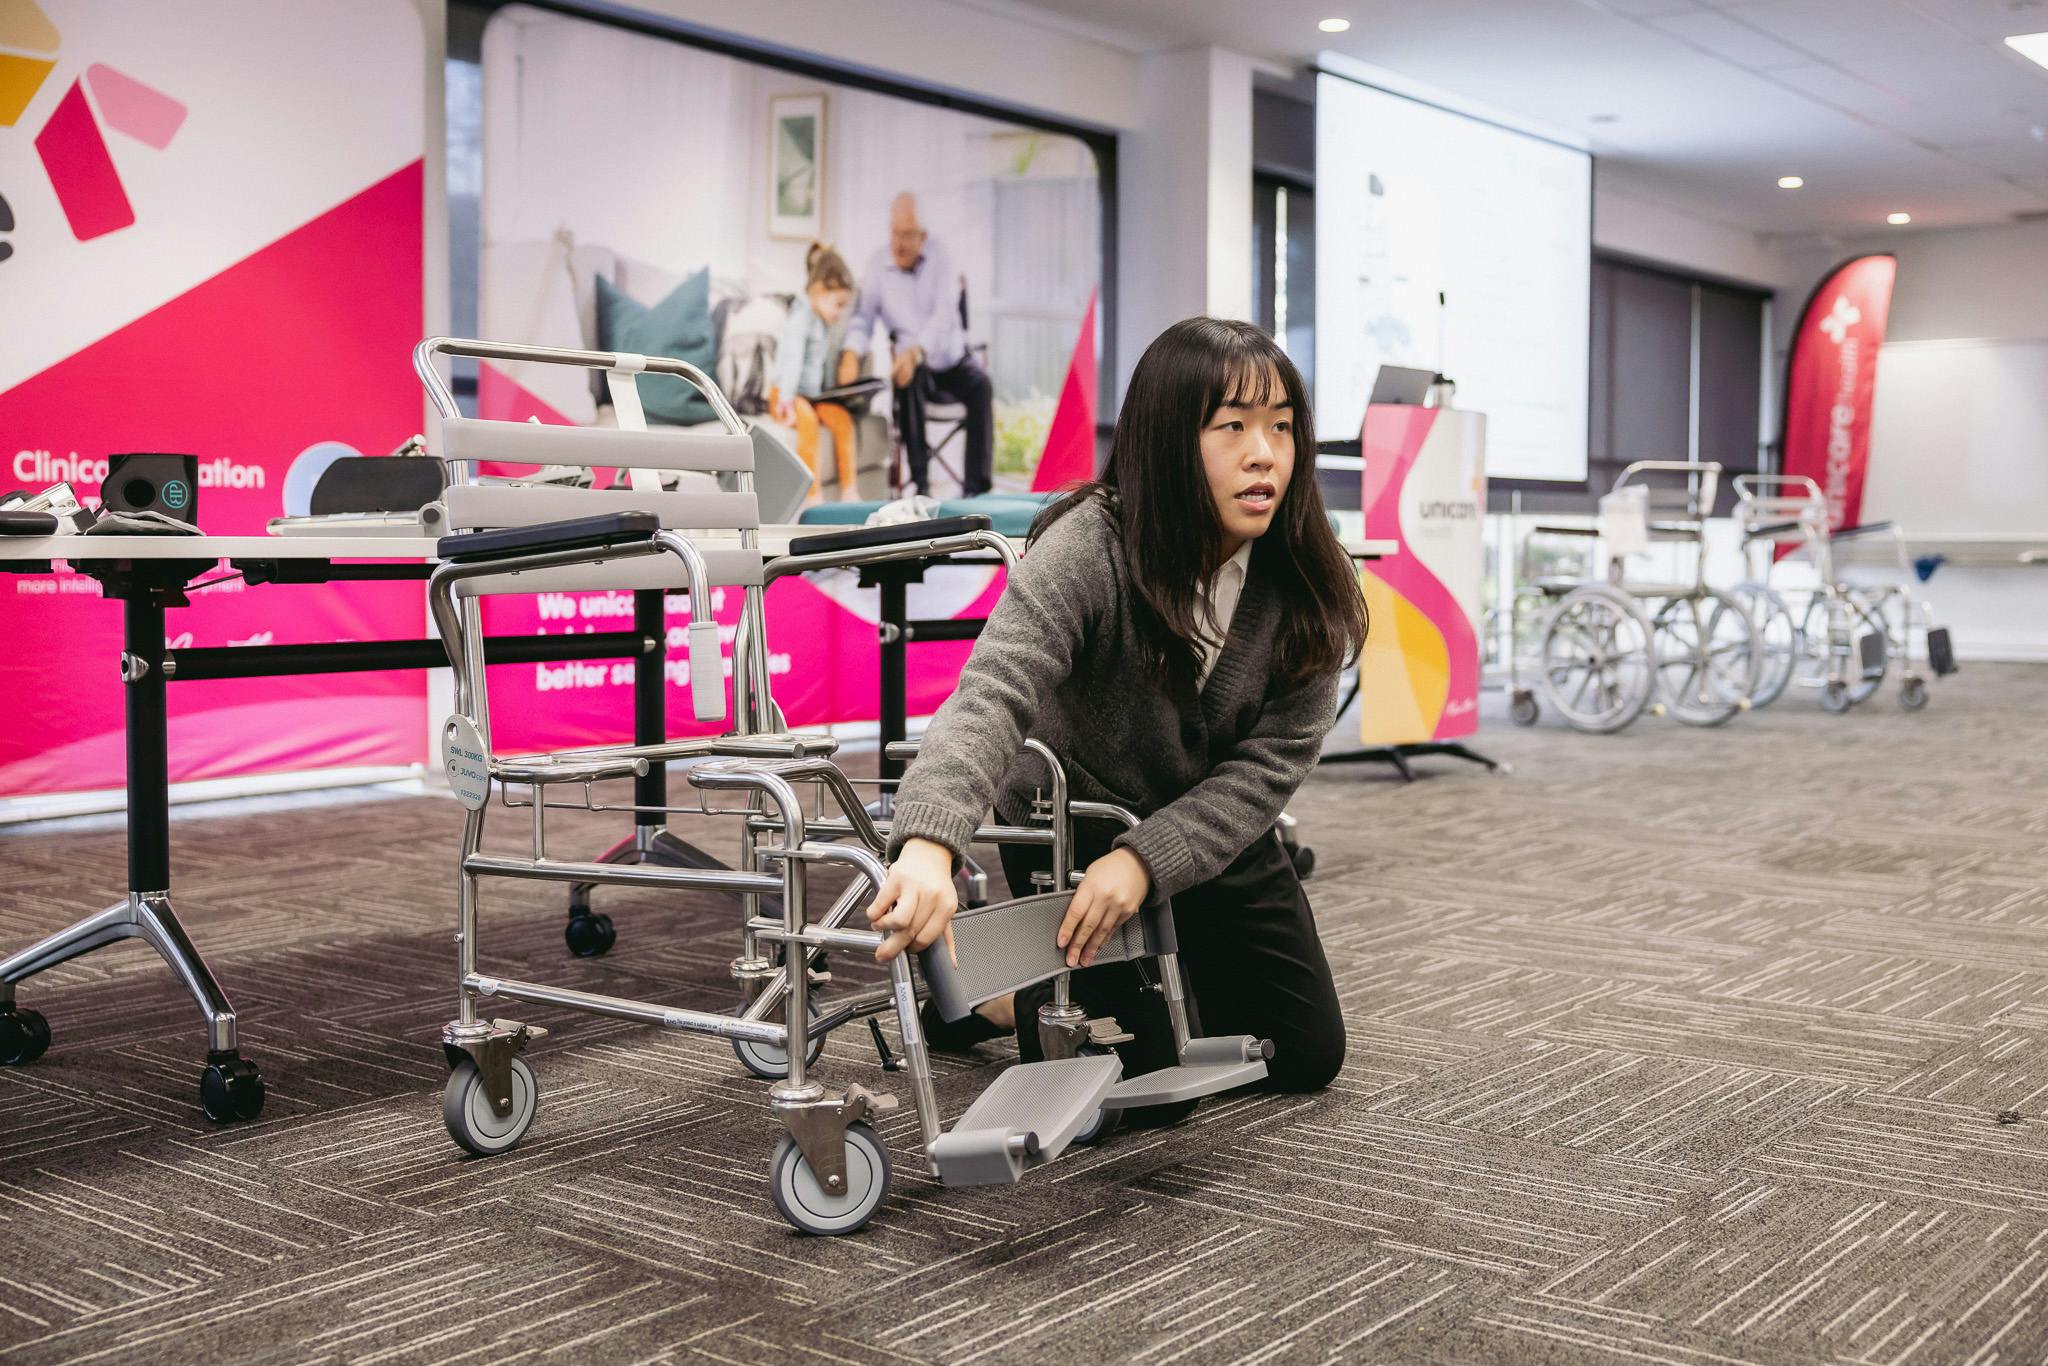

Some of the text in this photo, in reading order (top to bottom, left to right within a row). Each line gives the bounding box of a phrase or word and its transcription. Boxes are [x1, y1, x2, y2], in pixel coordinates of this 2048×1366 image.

[13, 450, 265, 489] Clinica ation
[537, 591, 577, 620] We
[536, 661, 608, 692] better
[450, 746, 483, 762] SWL 300KG
